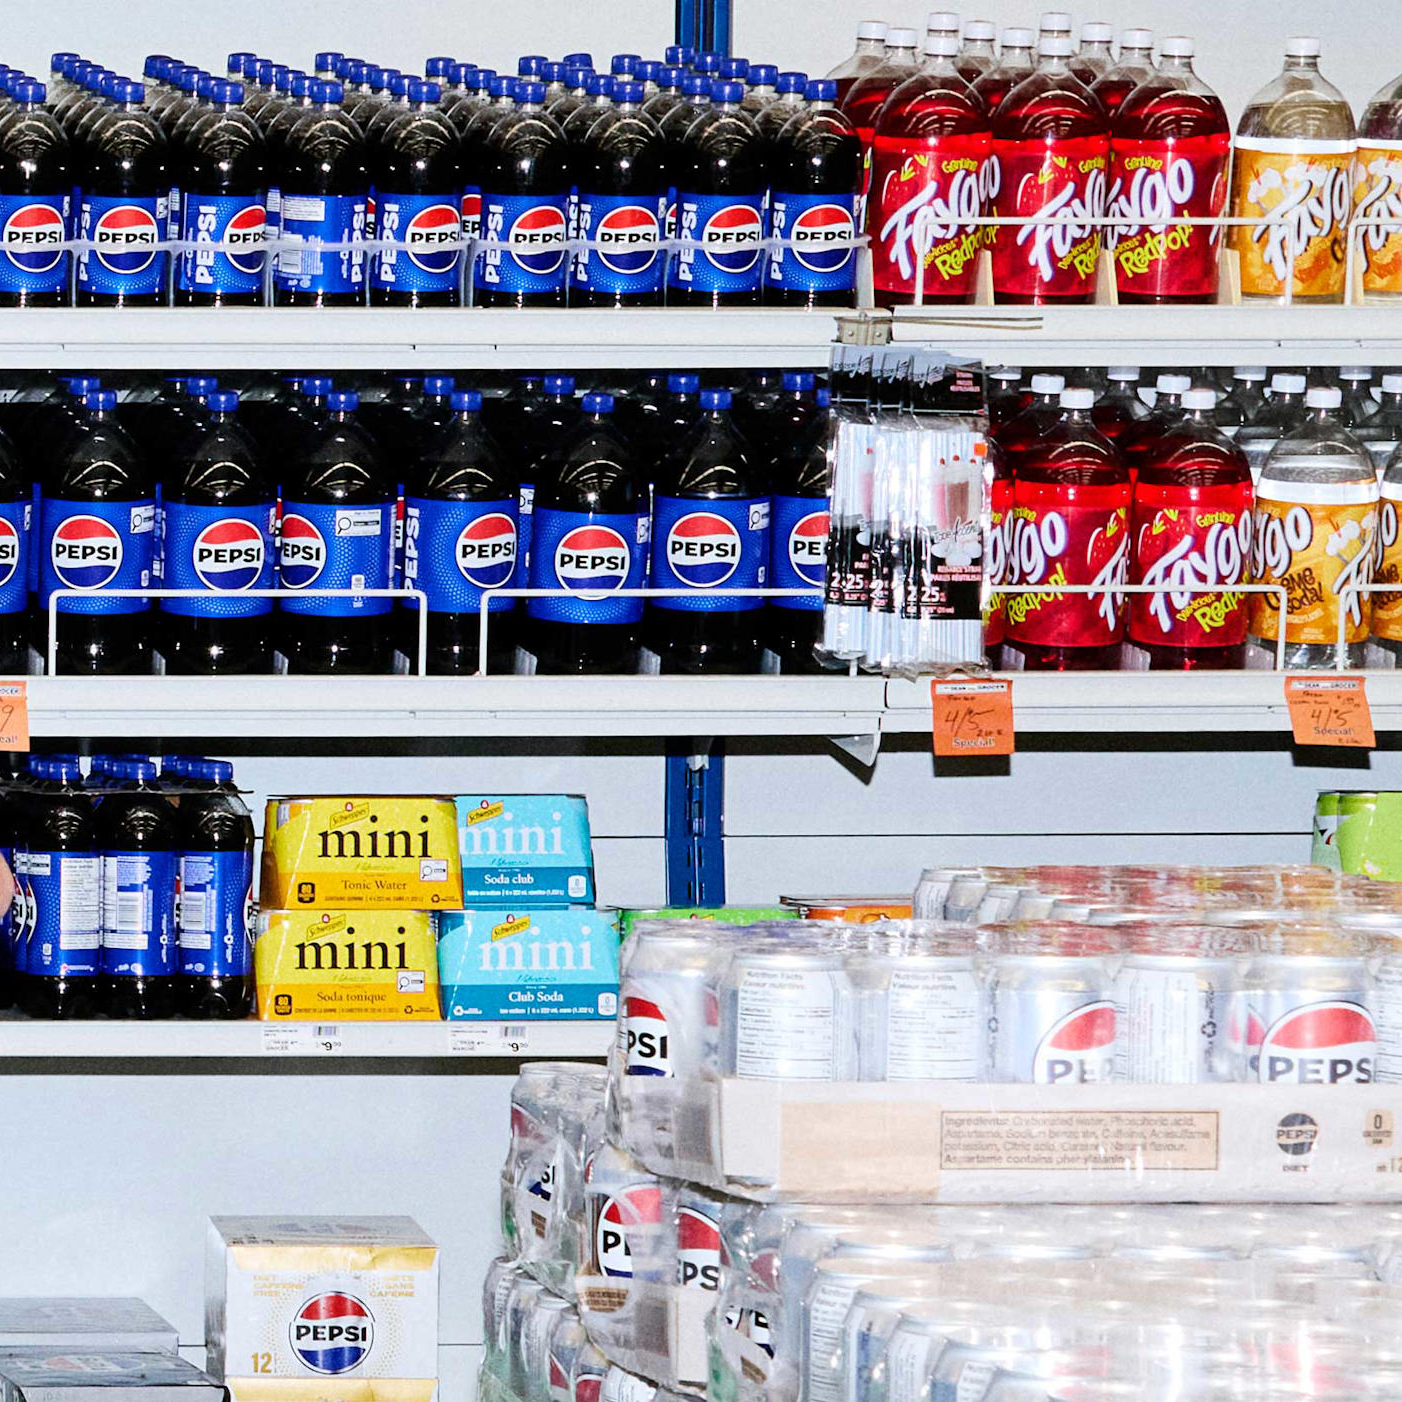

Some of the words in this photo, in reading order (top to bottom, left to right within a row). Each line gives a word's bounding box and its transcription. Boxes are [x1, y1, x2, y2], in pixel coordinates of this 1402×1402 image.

[55, 542, 118, 560] PEPSI
[198, 547, 261, 565] PEPSI
[461, 542, 515, 559] PEPSI
[671, 541, 736, 558] PEPSI
[559, 553, 626, 571] PEPSI
[318, 814, 433, 858] mini
[461, 811, 566, 855] mini
[341, 879, 373, 890] Tonic
[376, 879, 408, 890] Water
[484, 873, 510, 884] Soda
[512, 872, 535, 884] club
[295, 926, 410, 970] mini
[479, 925, 595, 971] mini
[317, 991, 343, 1002] Soda
[345, 991, 387, 1004] tonique
[508, 991, 534, 1002] Club
[537, 991, 564, 1002] Soda
[295, 1324, 367, 1342] PEPSI
[251, 1353, 272, 1374] 12
